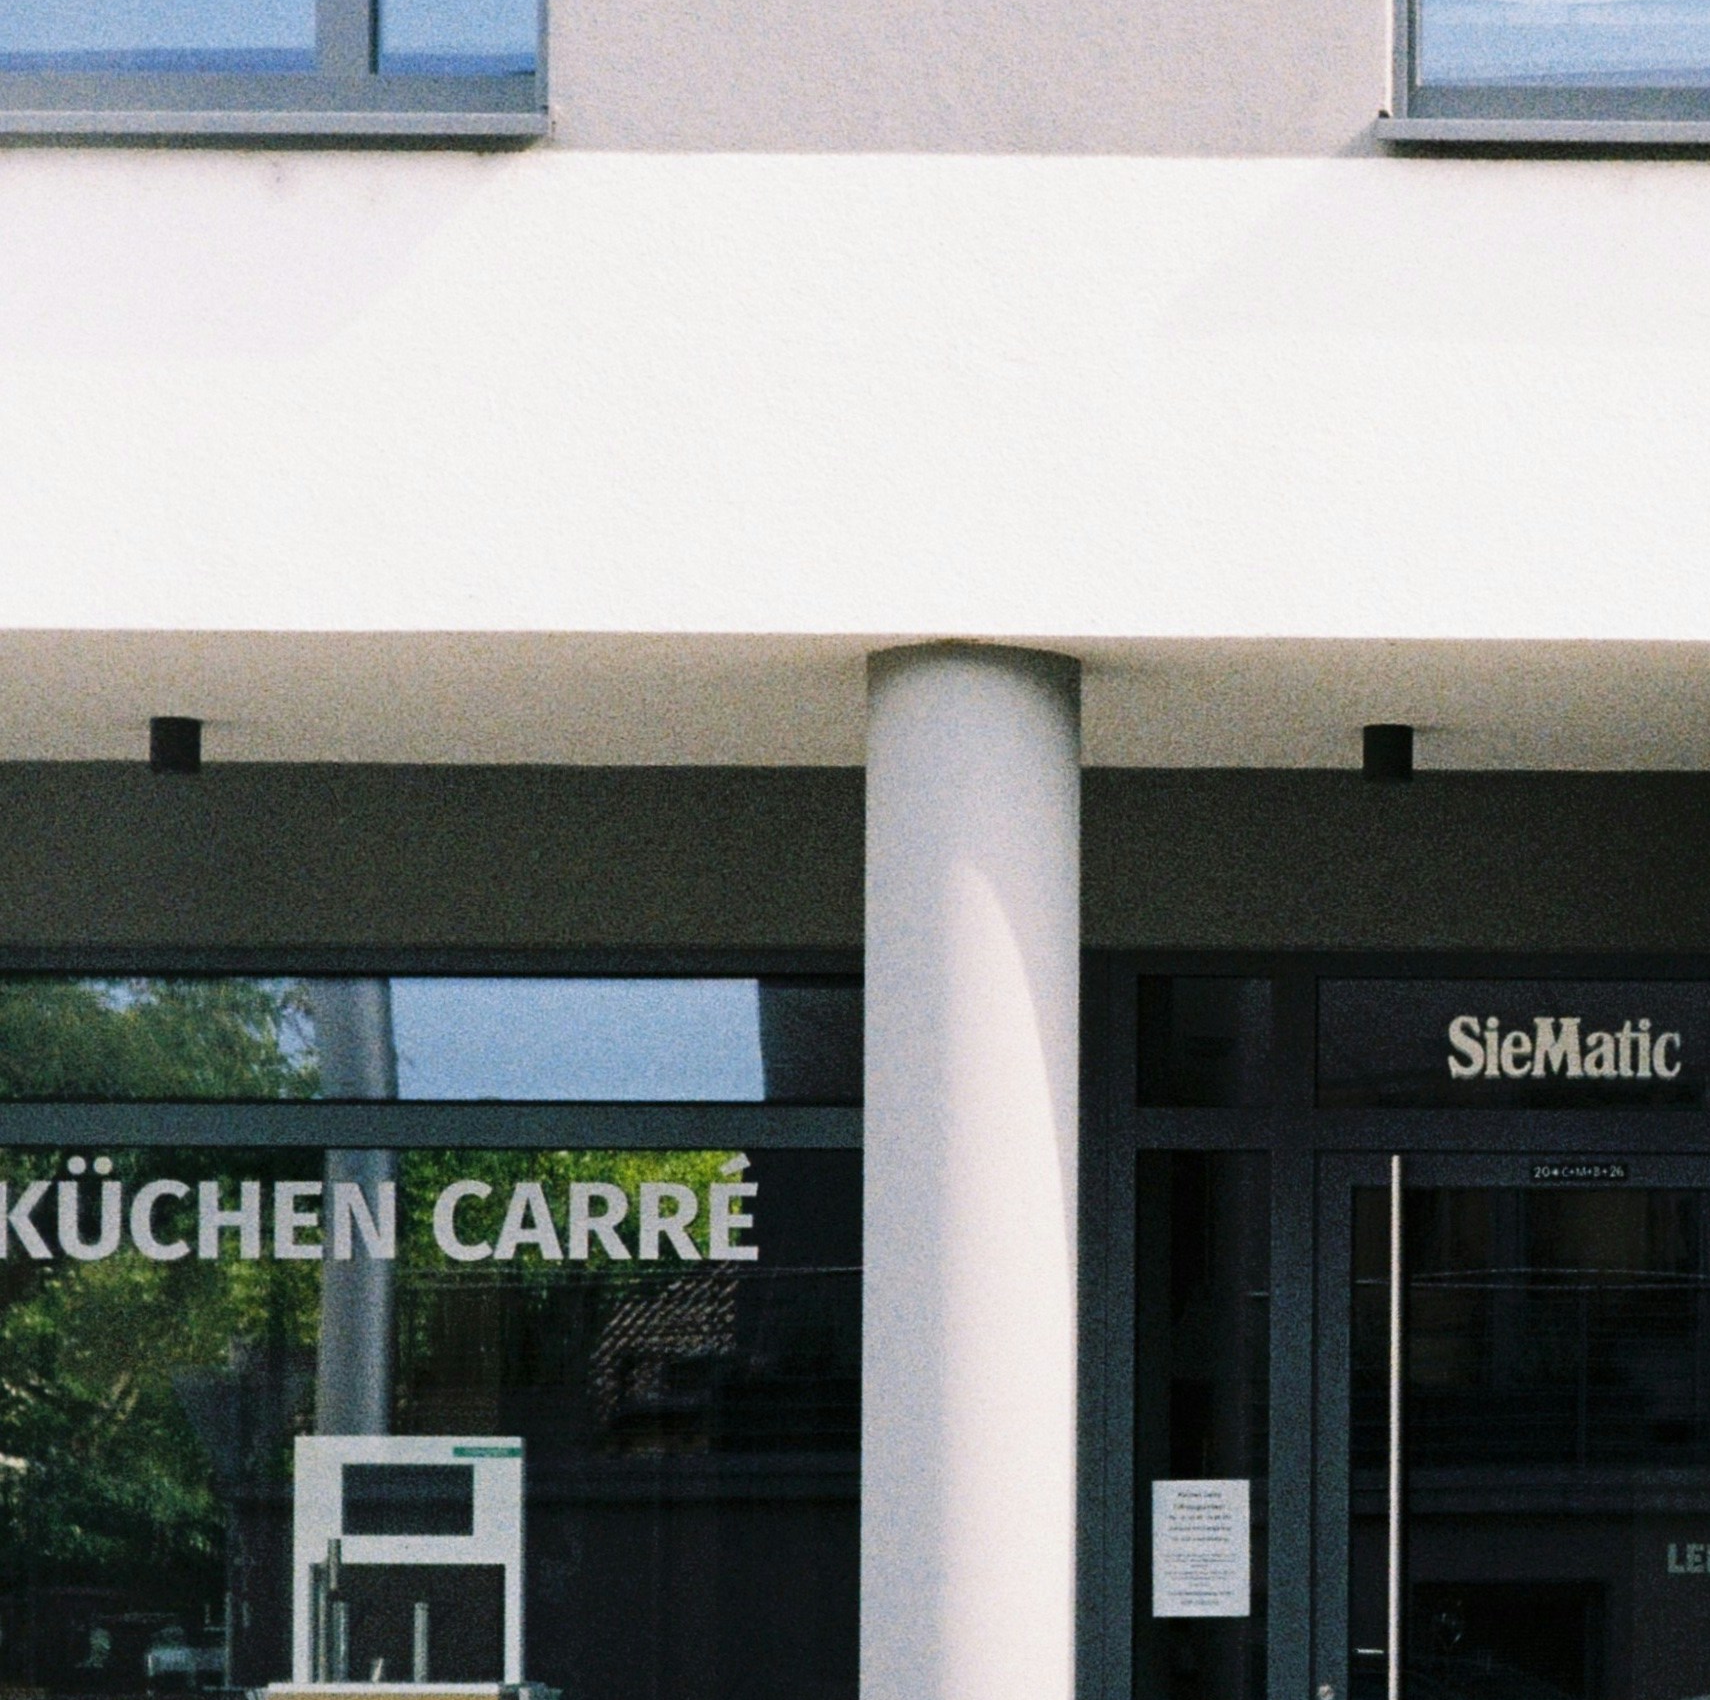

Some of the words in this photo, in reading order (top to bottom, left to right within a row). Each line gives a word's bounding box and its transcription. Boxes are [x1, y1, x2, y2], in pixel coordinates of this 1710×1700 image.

[1448, 1015, 1681, 1079] SieMatic
[0, 1155, 397, 1261] KÜCHEN
[433, 1152, 759, 1262] CARRÉ
